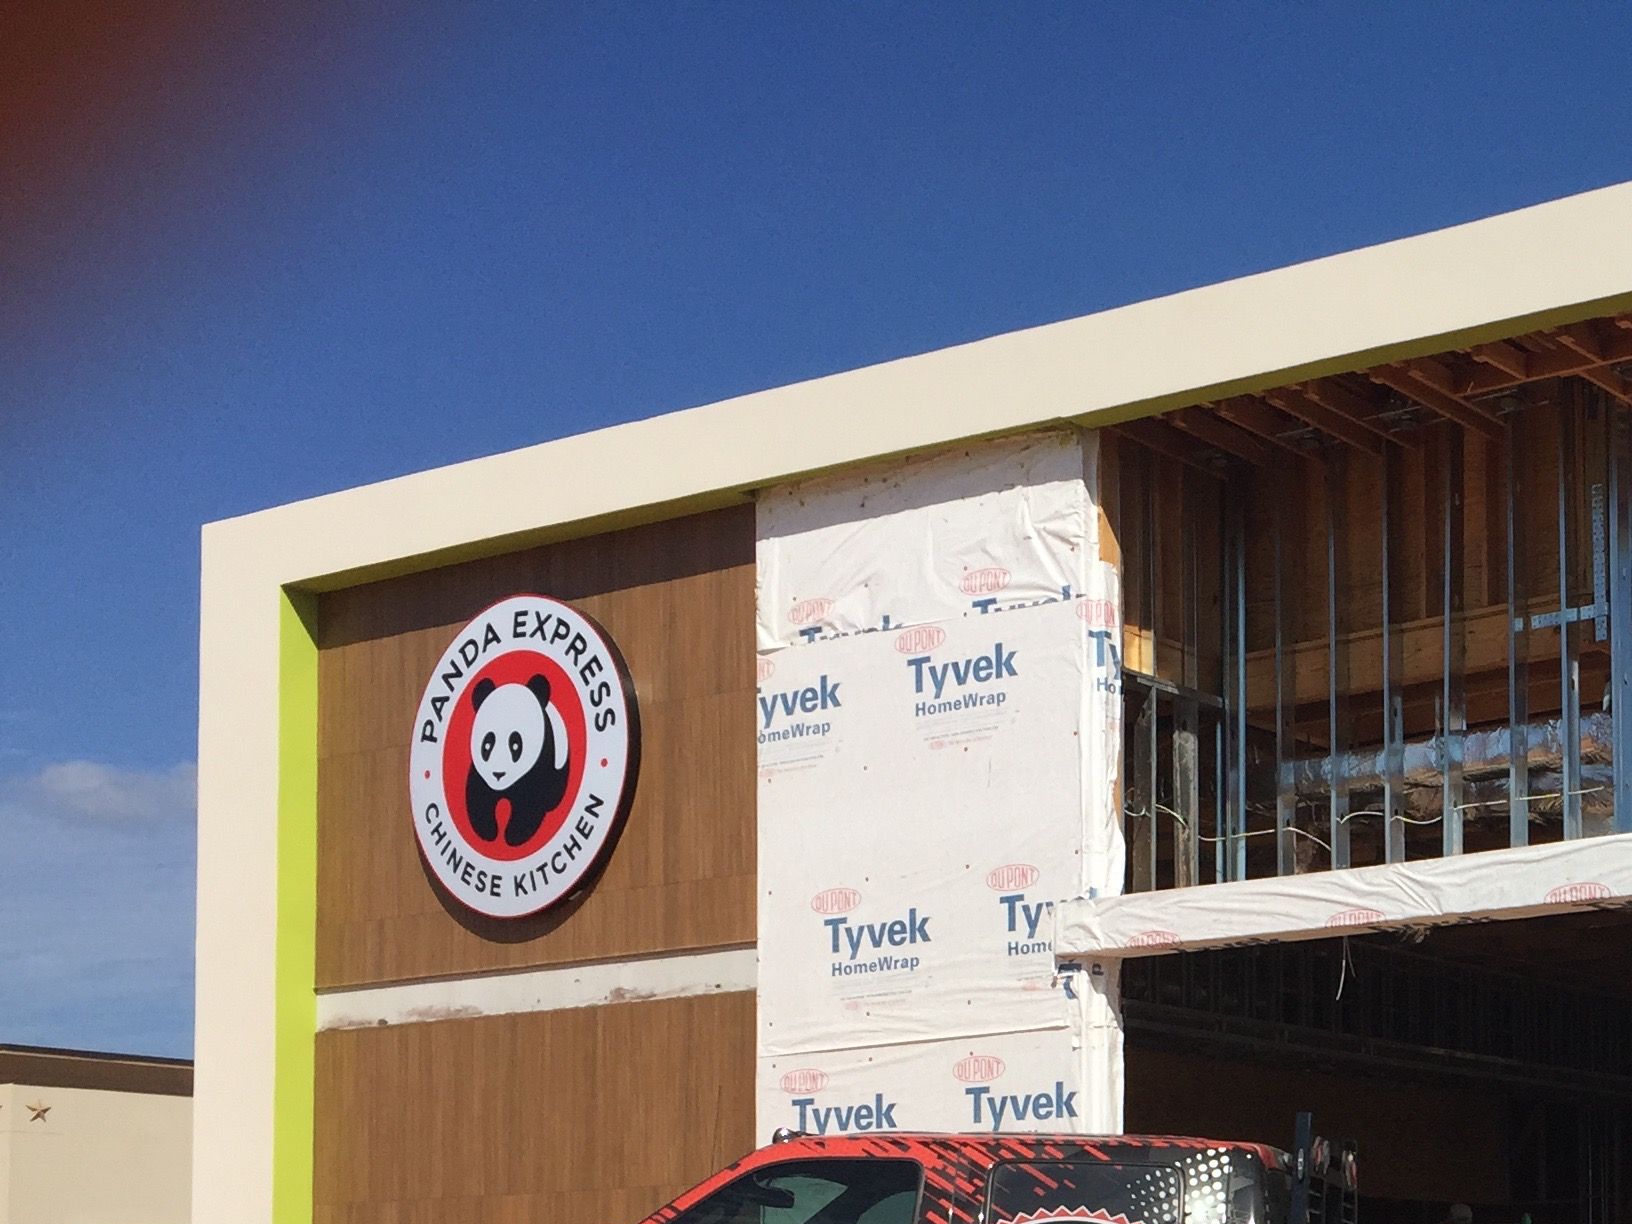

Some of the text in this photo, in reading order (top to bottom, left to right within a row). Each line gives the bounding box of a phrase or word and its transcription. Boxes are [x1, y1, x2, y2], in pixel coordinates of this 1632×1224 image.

[421, 609, 616, 744] PANDA EXPRESS
[906, 643, 1018, 699] Tyvek
[757, 674, 842, 729] yvek
[915, 691, 1006, 717] HomeWrap
[757, 721, 831, 745] omeWrap
[425, 793, 605, 898] CHINESE KITCHEN
[823, 907, 932, 961] Tyvek
[831, 955, 921, 977] HomeWrap
[965, 1081, 1079, 1133] Tyvek
